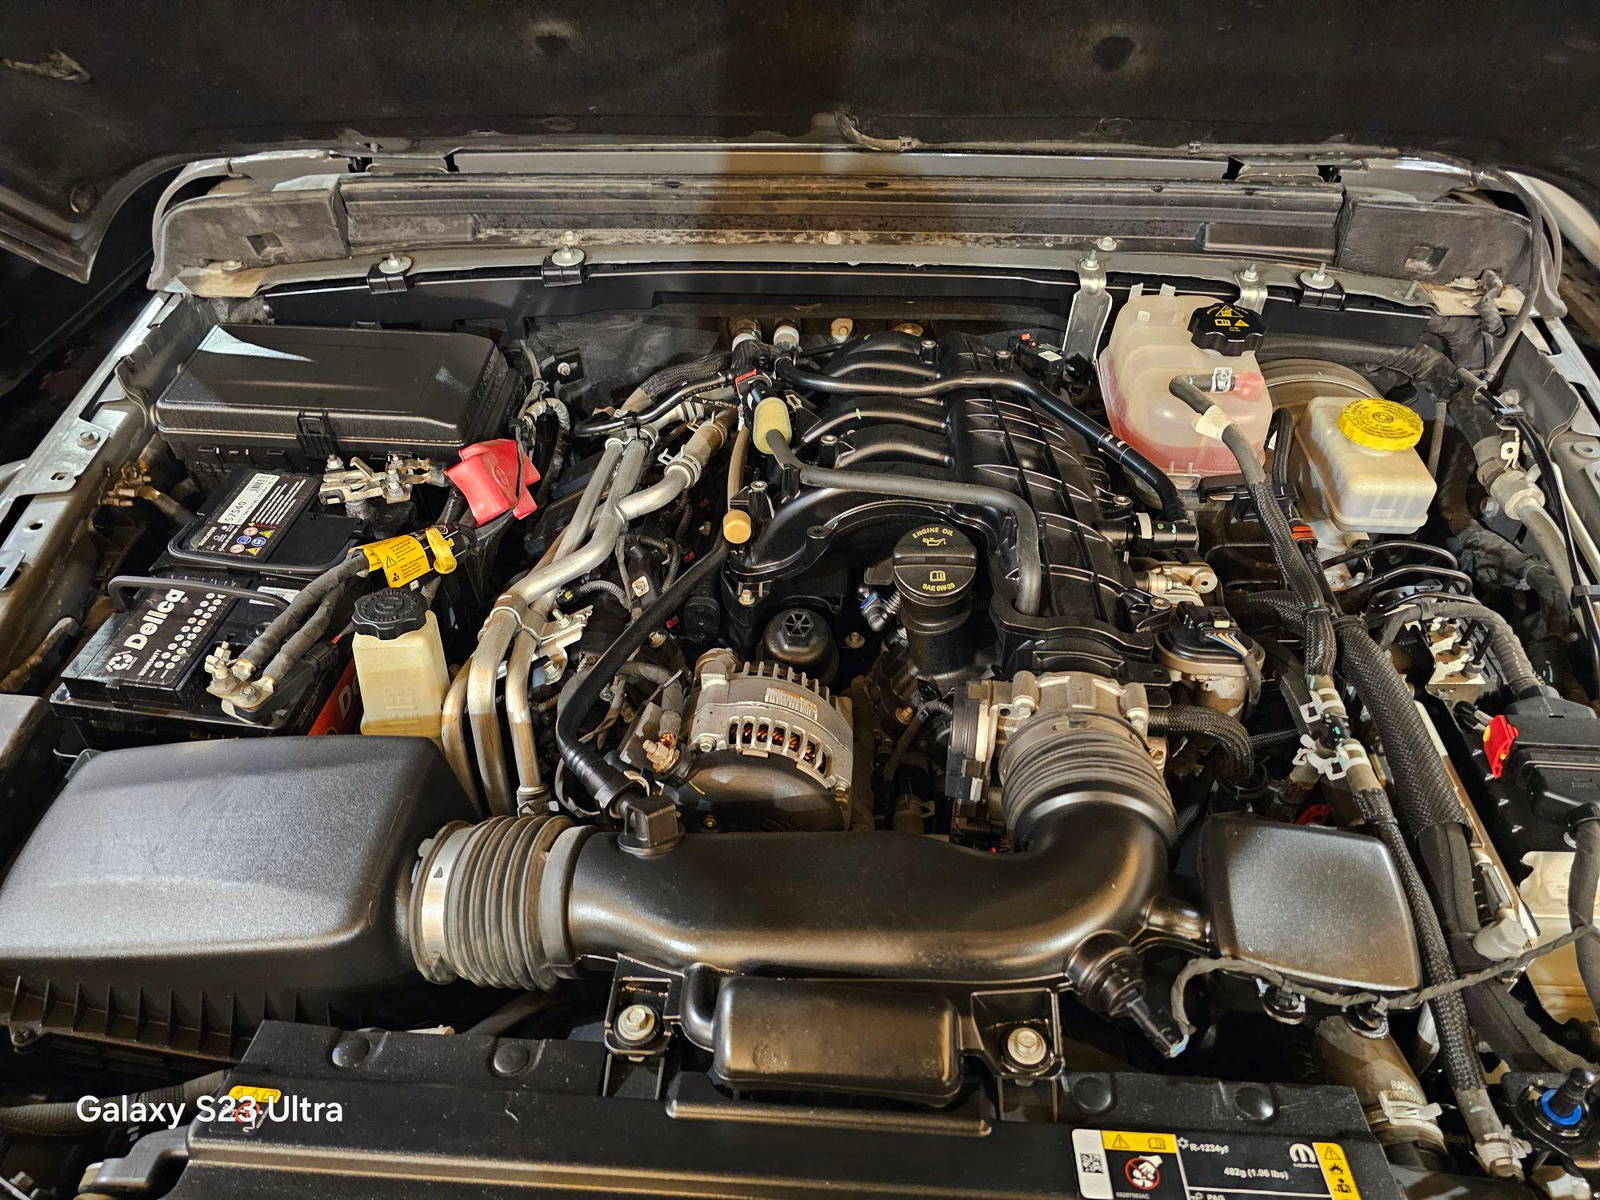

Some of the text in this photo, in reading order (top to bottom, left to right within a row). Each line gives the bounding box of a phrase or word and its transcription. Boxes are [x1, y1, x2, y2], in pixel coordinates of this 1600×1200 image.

[912, 527, 954, 539] ENGINE OIL
[922, 583, 936, 592] SAE
[138, 648, 162, 676] WARRANTY
